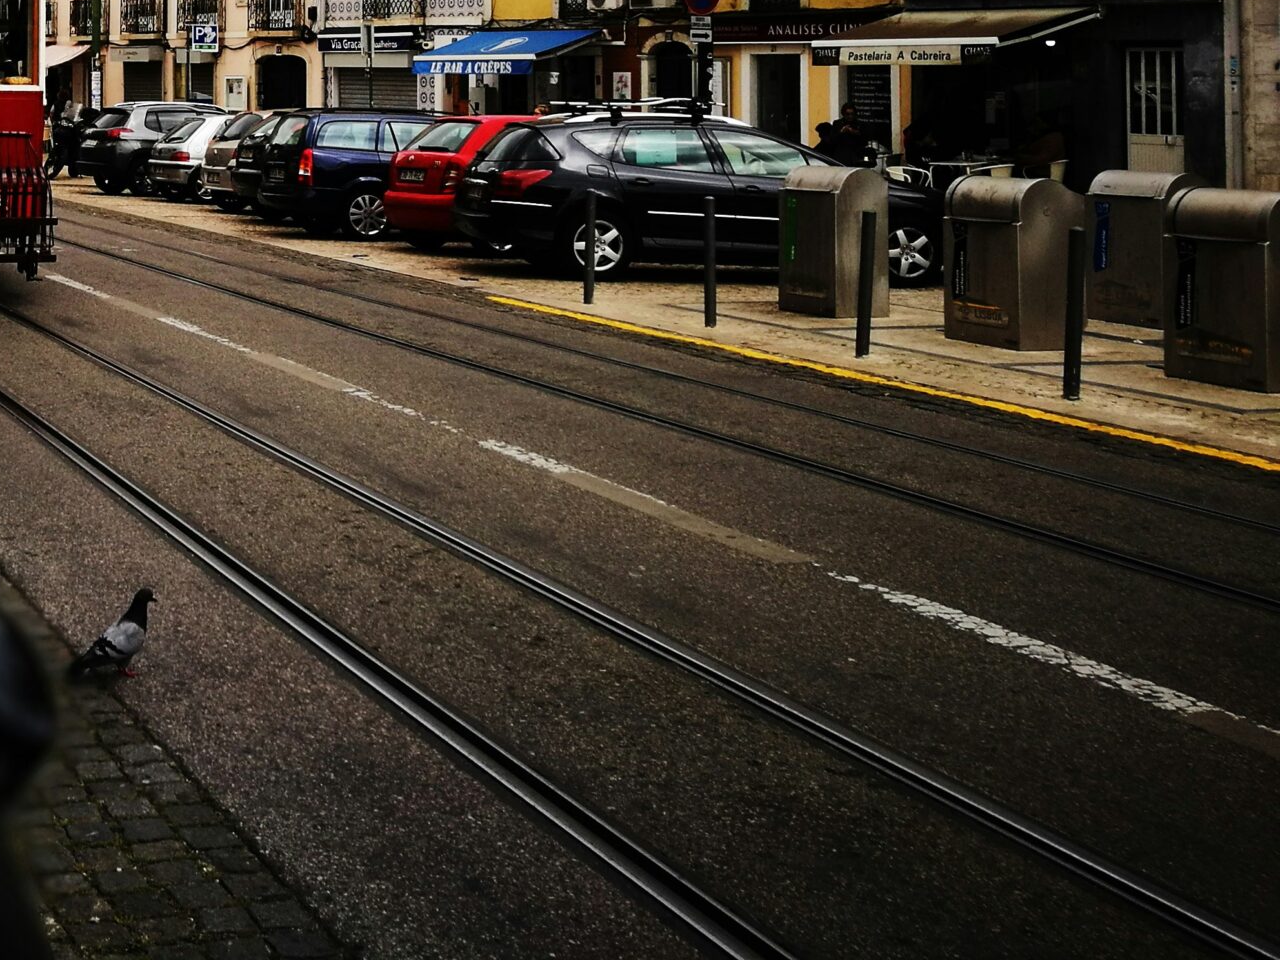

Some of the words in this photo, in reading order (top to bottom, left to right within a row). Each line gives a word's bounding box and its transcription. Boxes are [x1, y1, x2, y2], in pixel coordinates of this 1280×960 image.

[195, 27, 205, 41] P
[767, 23, 824, 36] ANALISES
[331, 39, 342, 49] Via
[342, 39, 361, 50] Graça
[848, 50, 892, 61] Pastelaria
[897, 50, 905, 60] A
[910, 50, 951, 61] Cabreira
[430, 61, 443, 73] LE
[443, 61, 464, 73] BAR
[474, 59, 512, 74] CRÊPES
